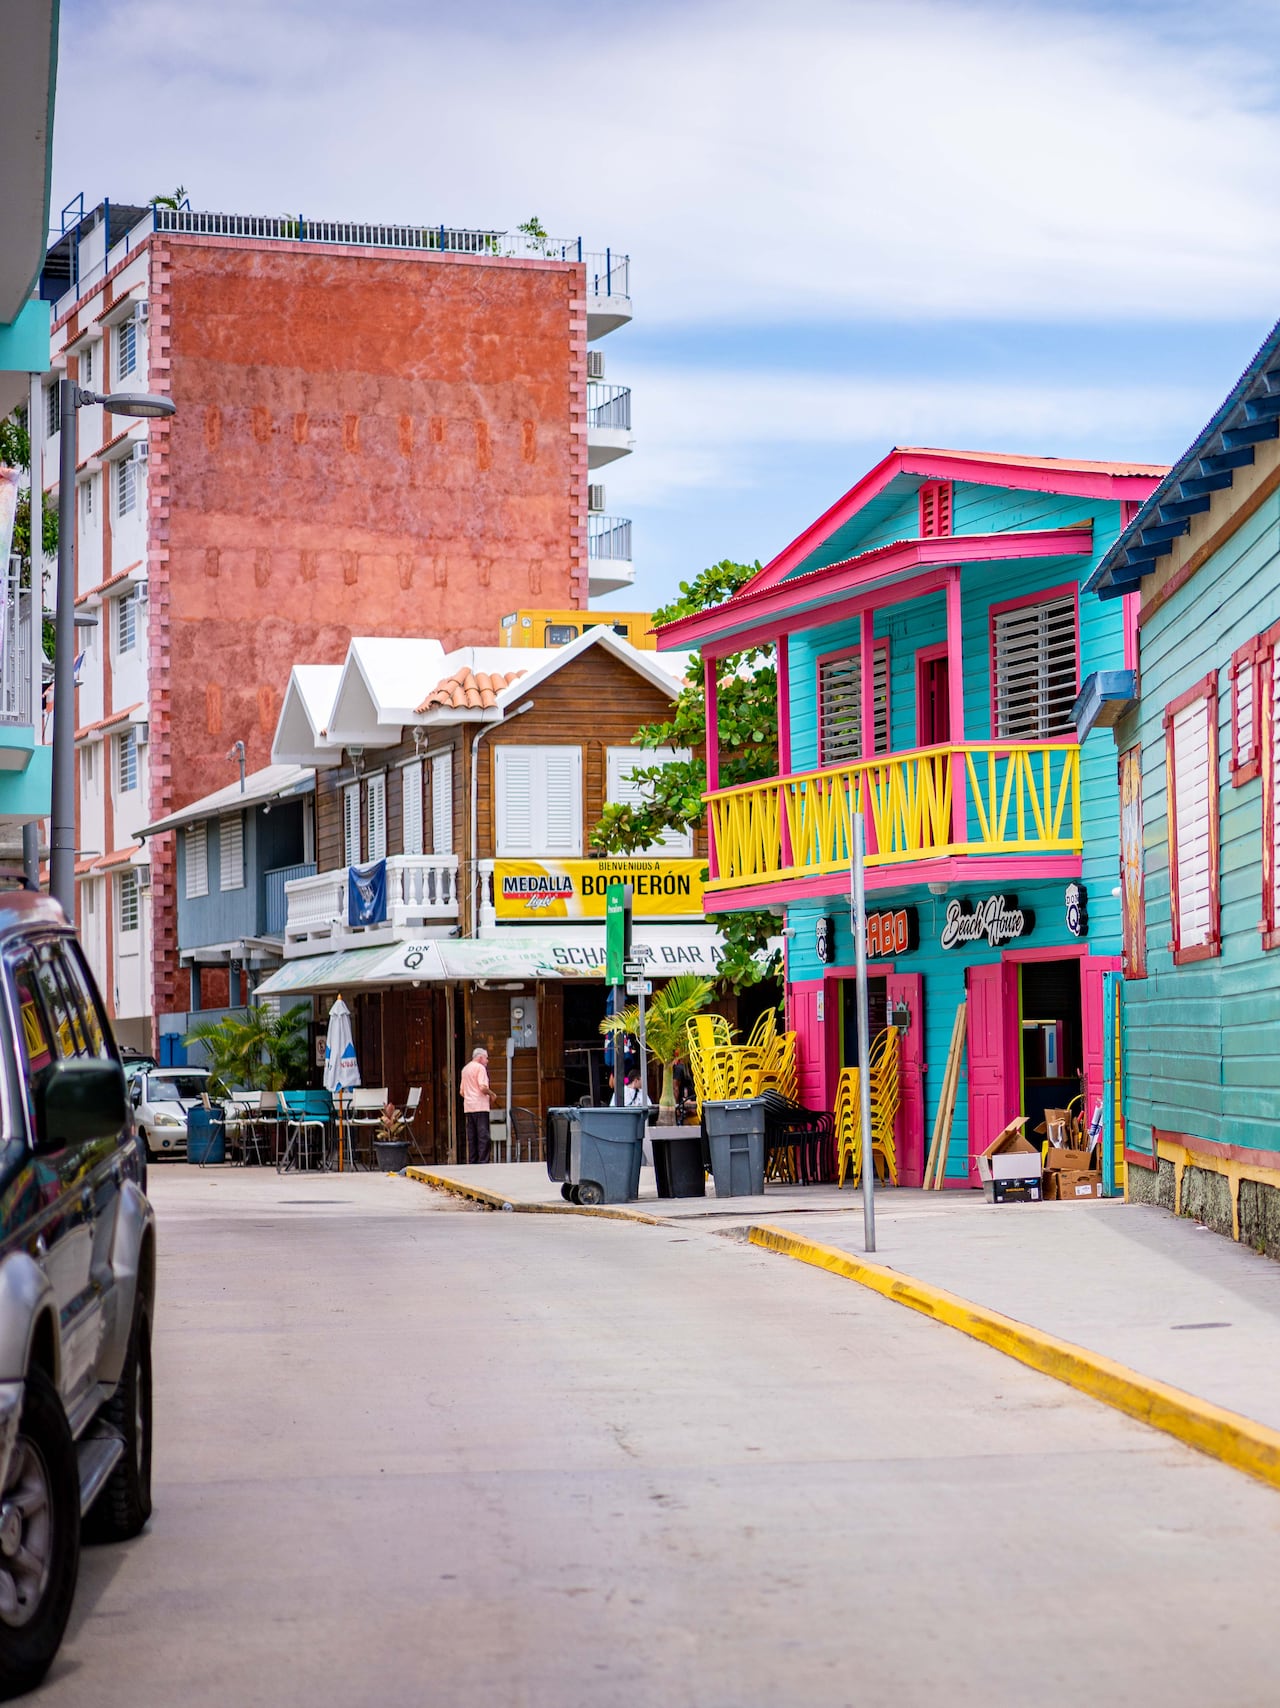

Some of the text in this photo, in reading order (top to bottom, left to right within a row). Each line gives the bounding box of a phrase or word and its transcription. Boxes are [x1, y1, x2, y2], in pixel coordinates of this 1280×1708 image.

[599, 861, 660, 871] BIENVENIDOS A
[503, 876, 573, 892] MEDALLA
[524, 894, 556, 910] Light
[942, 896, 1022, 947] Beach House
[1067, 904, 1080, 934] Q
[862, 910, 908, 957] ABO
[404, 952, 424, 970] Q
[660, 946, 704, 964] BAR
